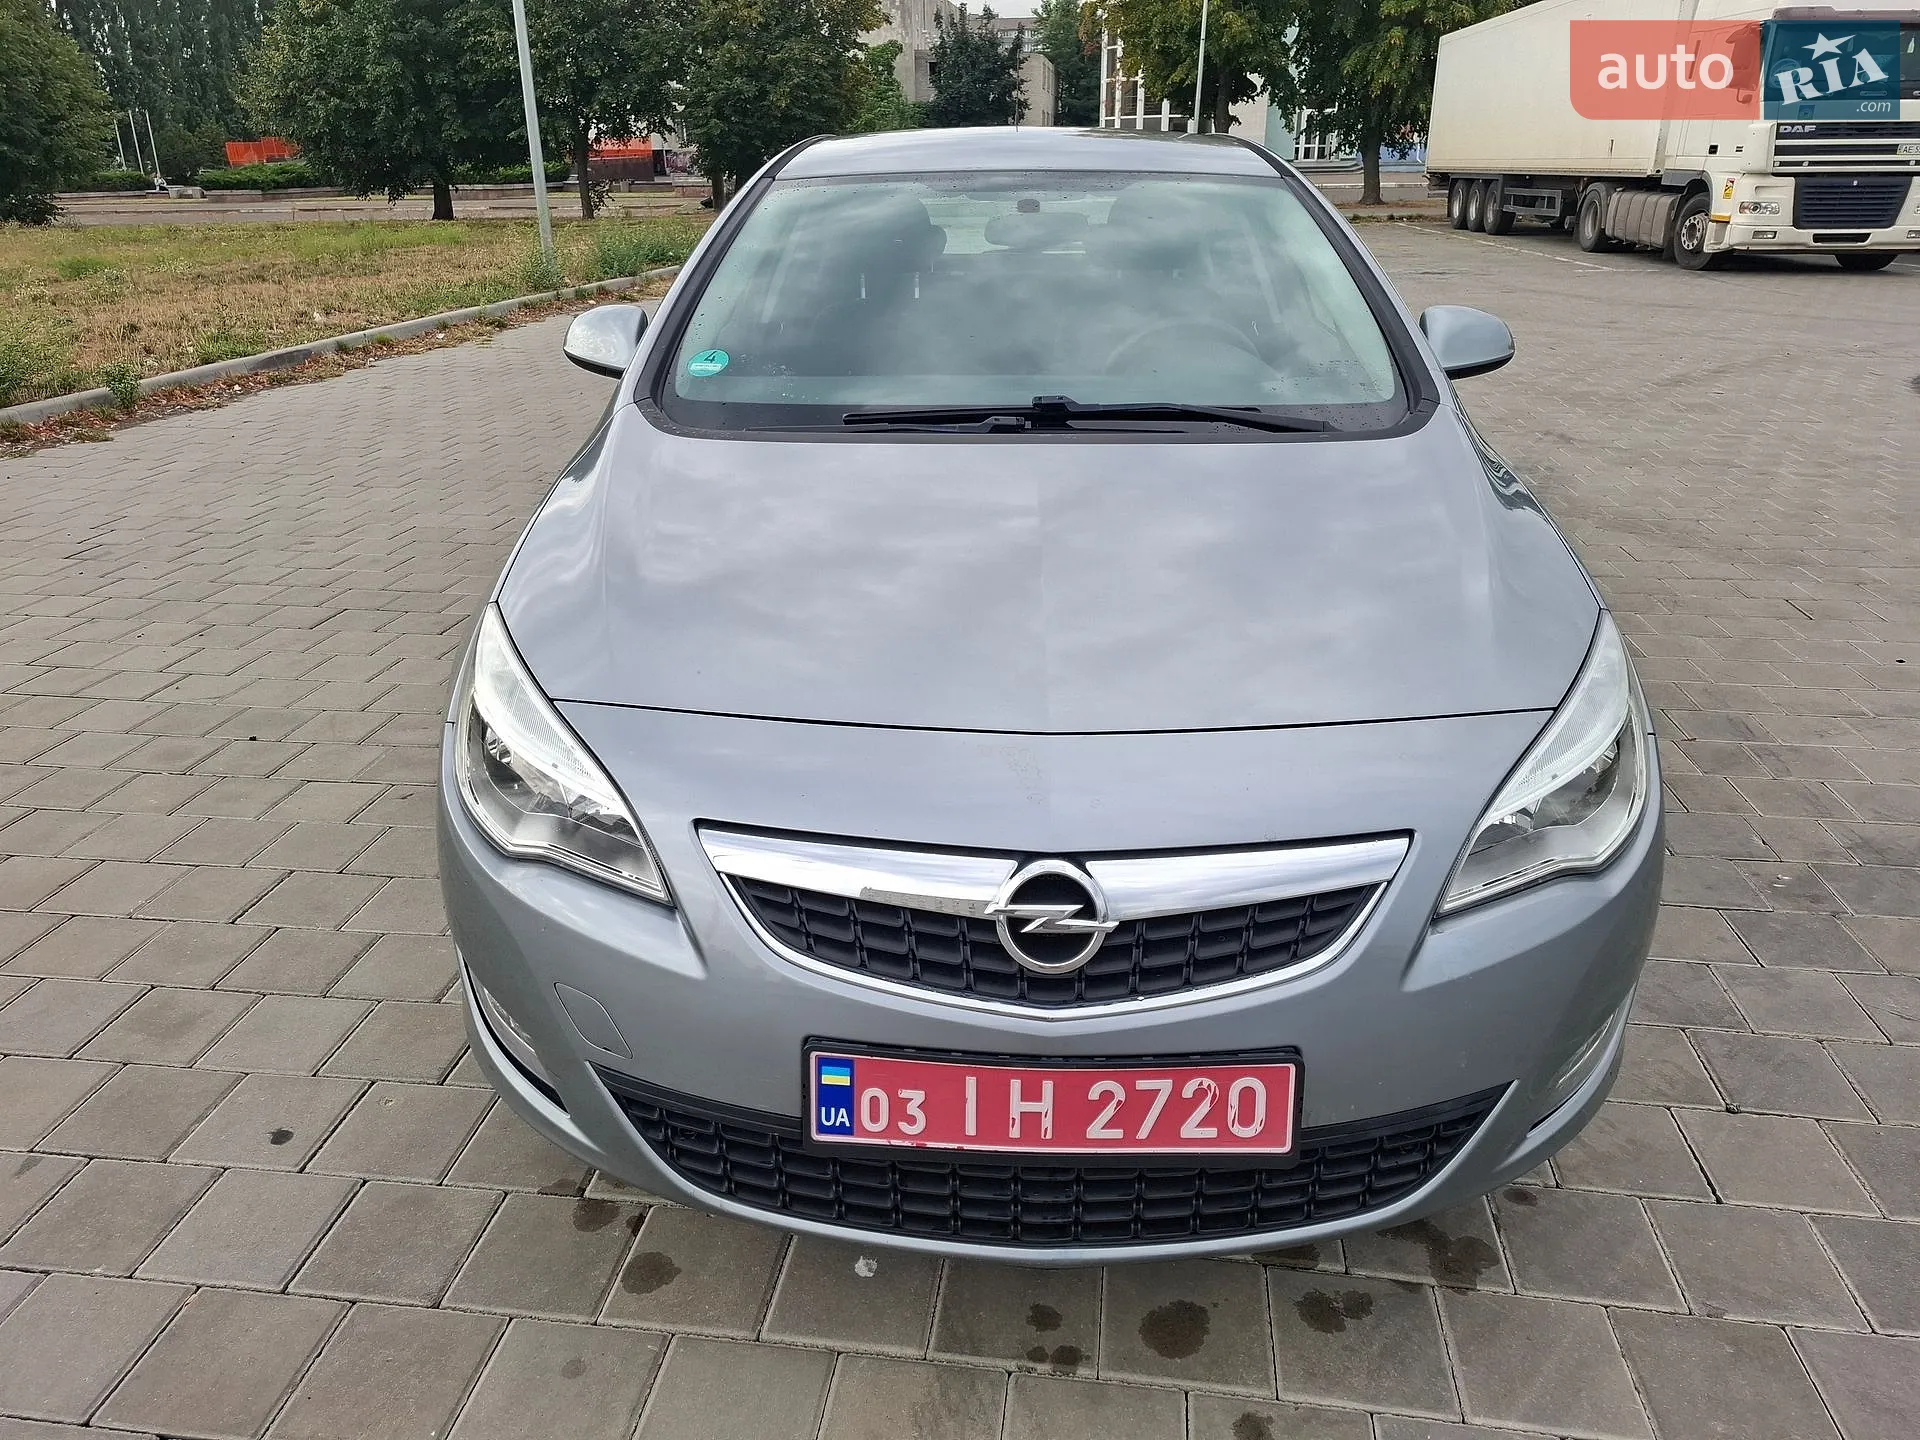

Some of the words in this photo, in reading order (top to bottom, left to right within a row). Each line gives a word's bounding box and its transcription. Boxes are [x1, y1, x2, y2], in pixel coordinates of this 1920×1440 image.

[1780, 125, 1817, 133] DAF
[704, 350, 717, 363] 4
[821, 1106, 850, 1127] UA
[860, 1087, 926, 1135] 03
[1086, 1077, 1267, 1139] 2720
